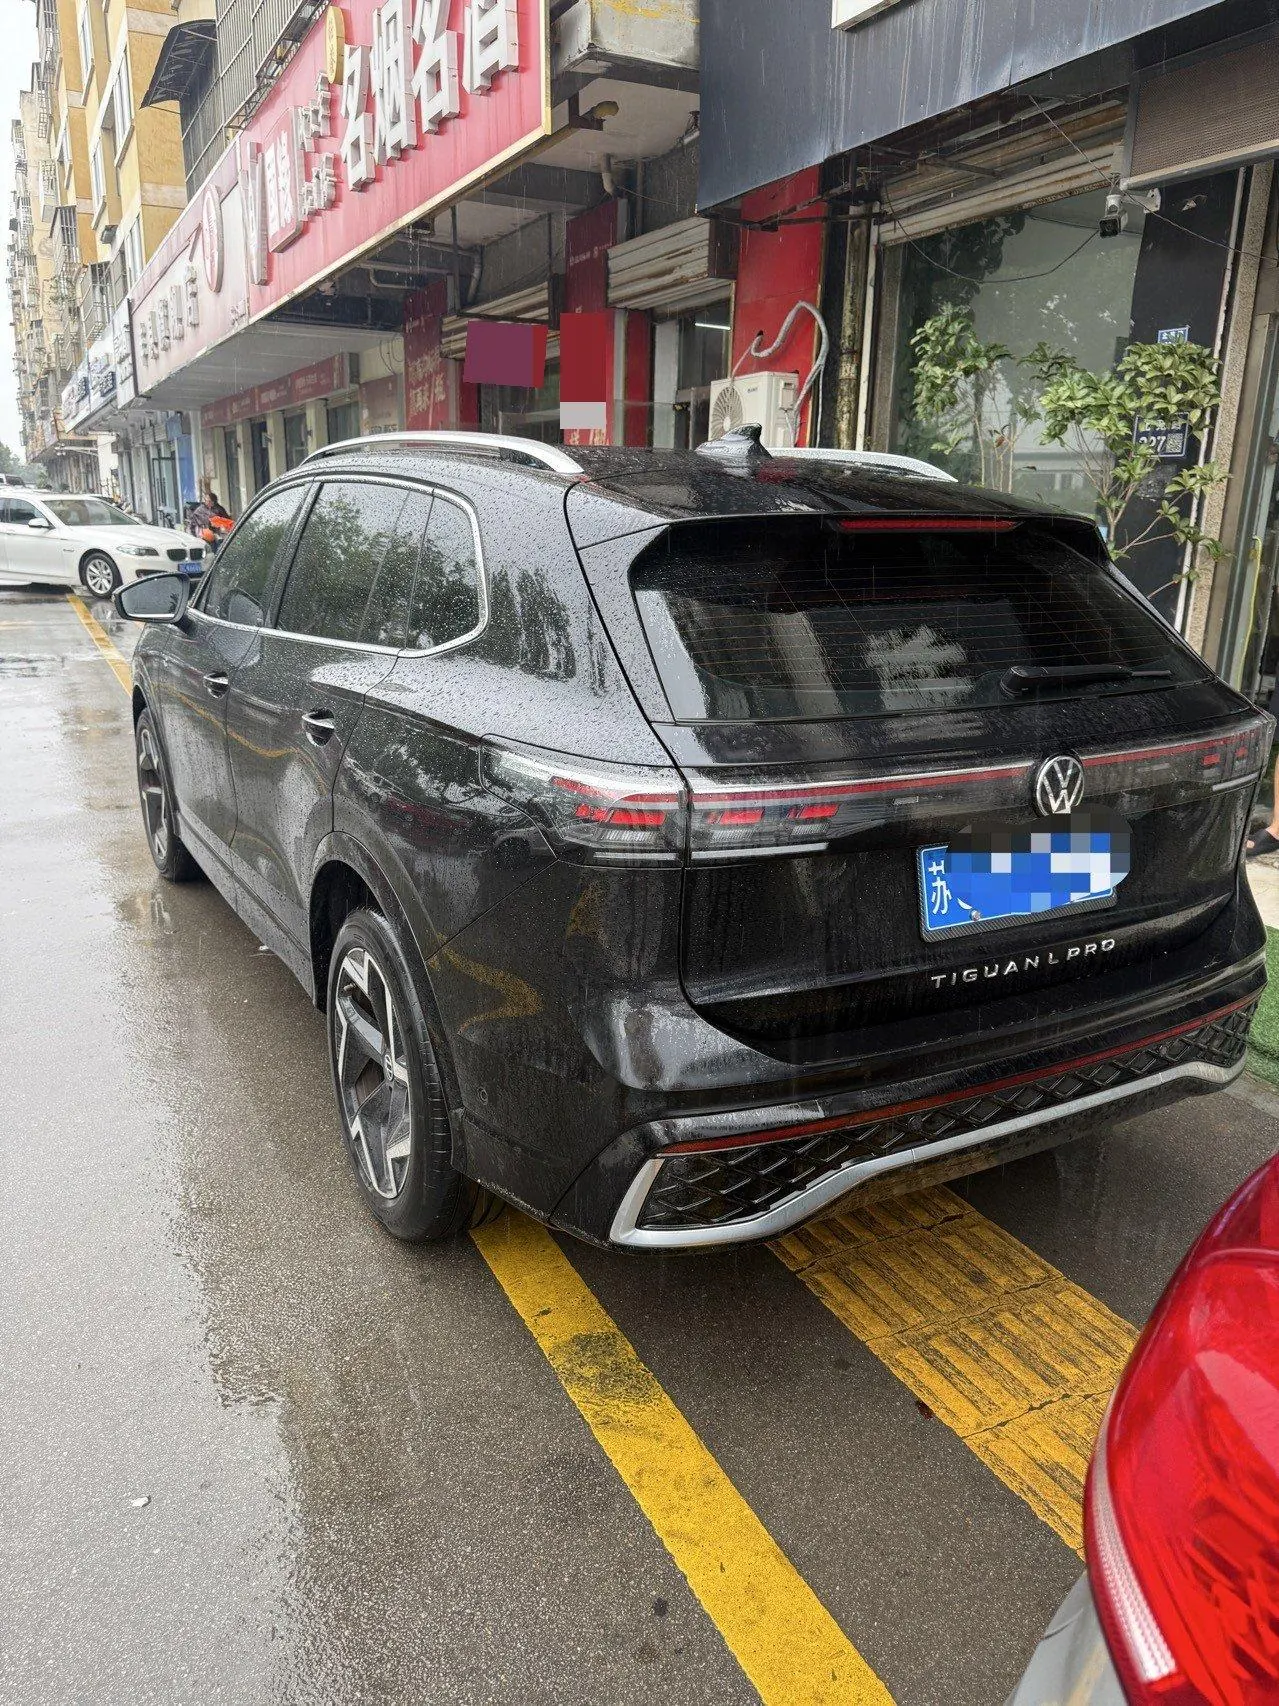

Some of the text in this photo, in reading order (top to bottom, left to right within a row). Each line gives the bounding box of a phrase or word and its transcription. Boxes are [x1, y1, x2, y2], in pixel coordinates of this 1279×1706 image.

[931, 938, 1115, 989] TIGUAN L PRO
